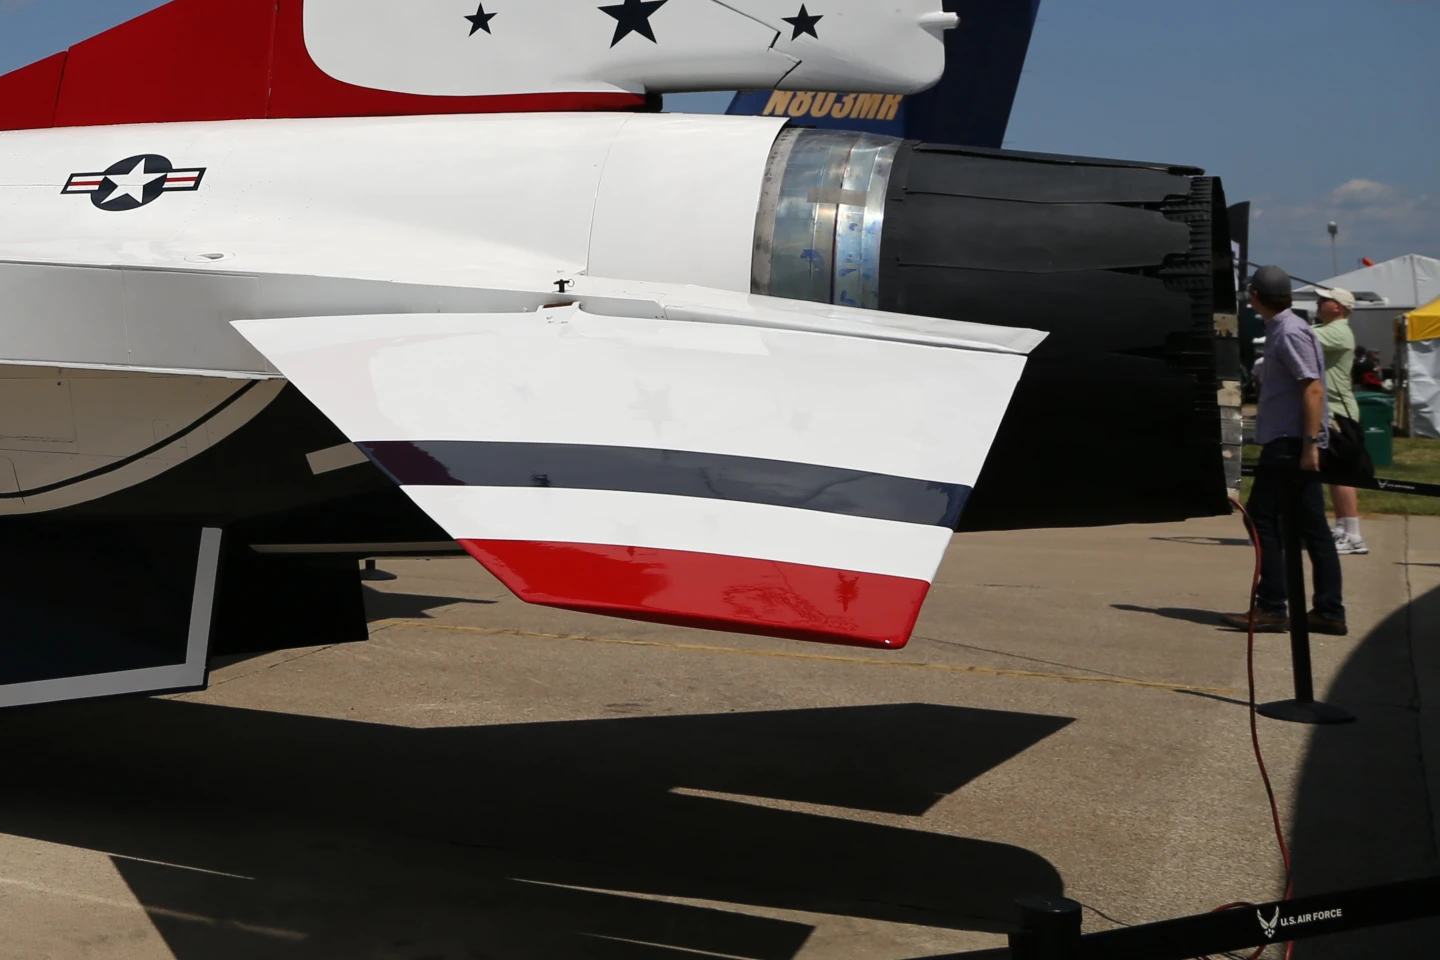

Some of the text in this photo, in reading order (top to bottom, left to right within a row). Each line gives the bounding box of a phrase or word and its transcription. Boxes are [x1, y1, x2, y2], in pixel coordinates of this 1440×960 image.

[1280, 908, 1343, 926] U.S. AIR FORCE
